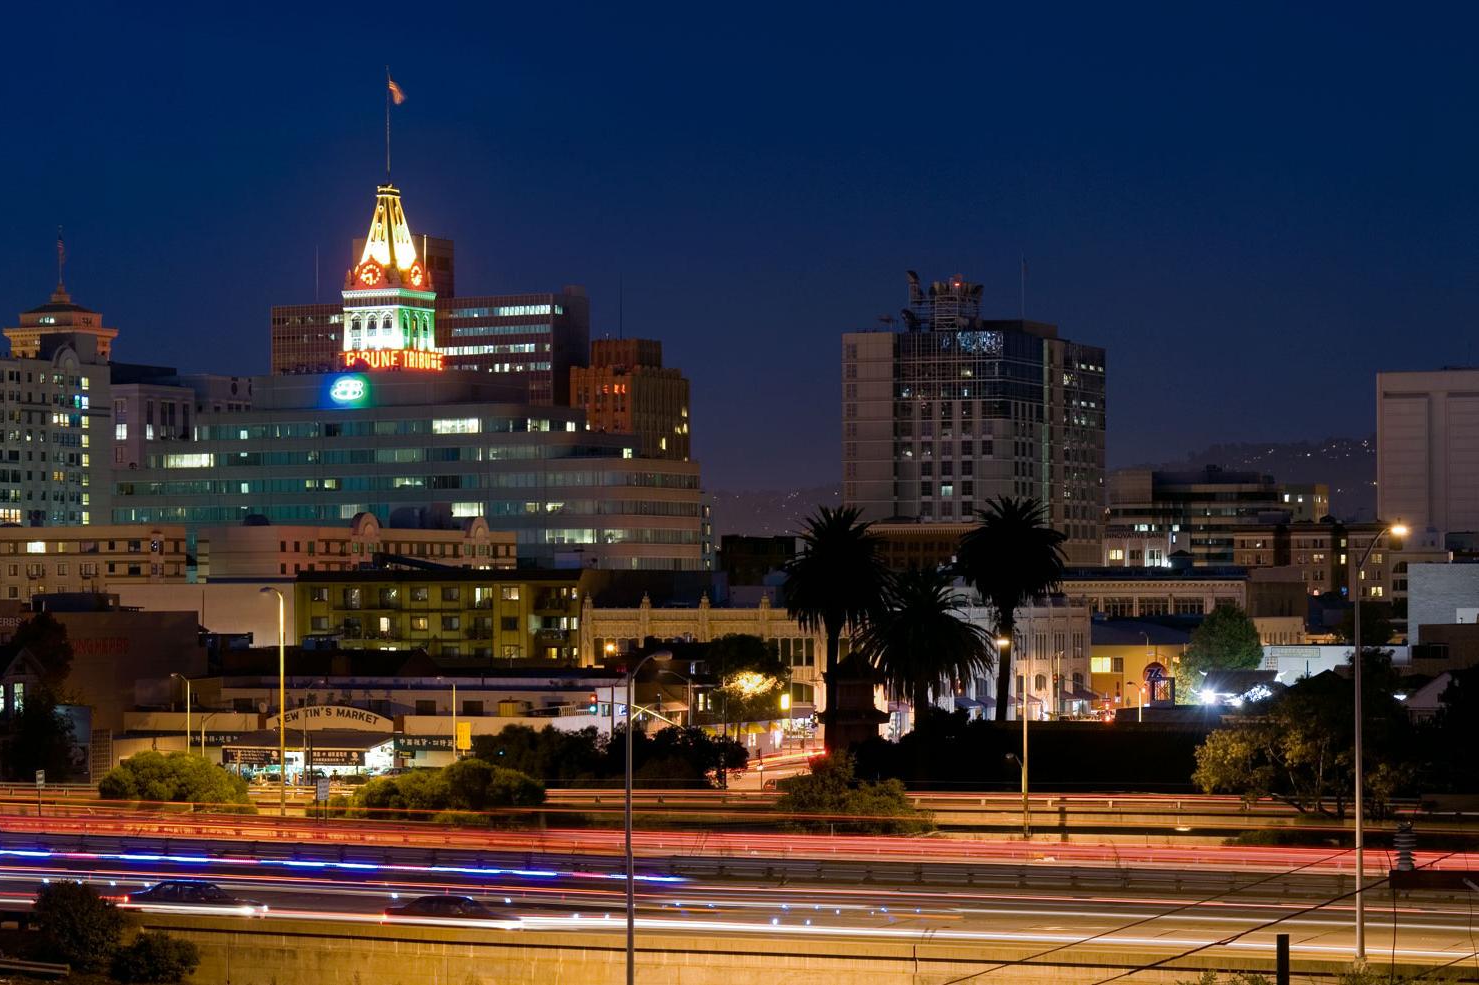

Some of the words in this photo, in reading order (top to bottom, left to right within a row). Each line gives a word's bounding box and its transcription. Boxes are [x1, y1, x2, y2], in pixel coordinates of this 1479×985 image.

[338, 350, 400, 369] RBUNE
[403, 350, 443, 371] TRIBUNE
[1146, 667, 1163, 681] 76
[277, 711, 299, 725] NEW
[302, 707, 332, 718] TIN'S
[336, 708, 380, 725] MARKET
